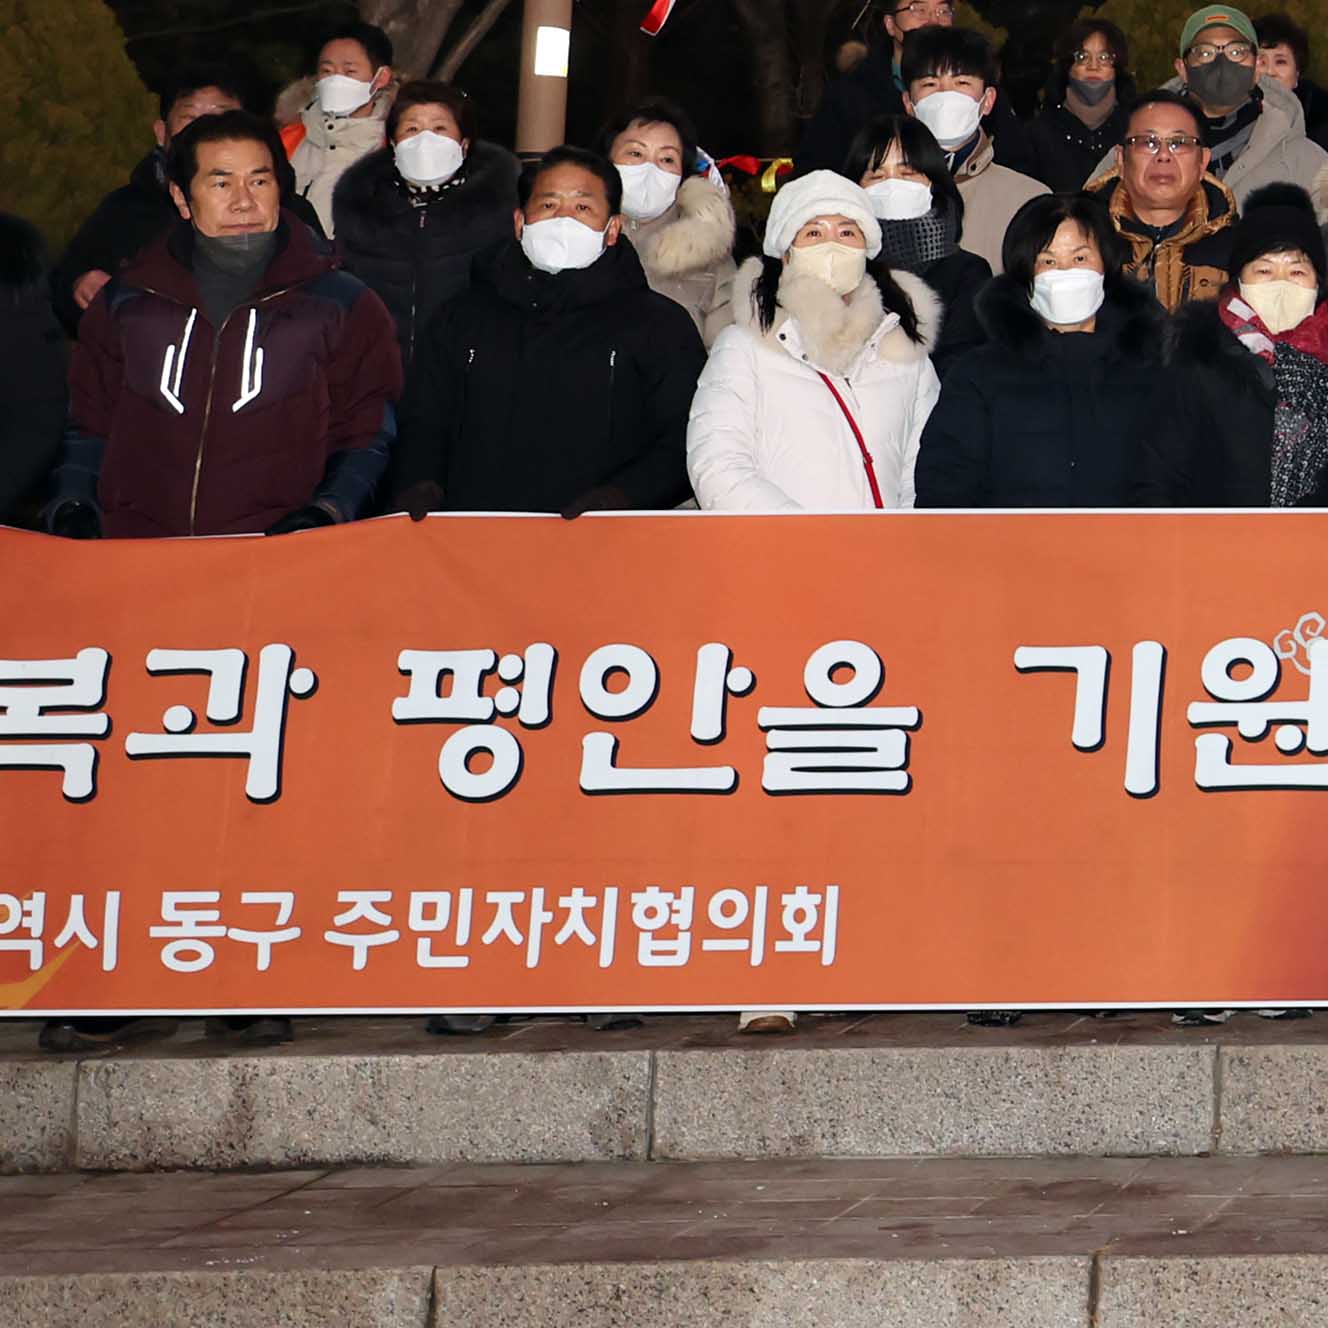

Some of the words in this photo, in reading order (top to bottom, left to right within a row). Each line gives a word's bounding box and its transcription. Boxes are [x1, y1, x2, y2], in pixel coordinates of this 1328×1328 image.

[391, 639, 923, 801] 평안을
[149, 891, 302, 972] 동구
[324, 885, 840, 970] 주민자치협의회
